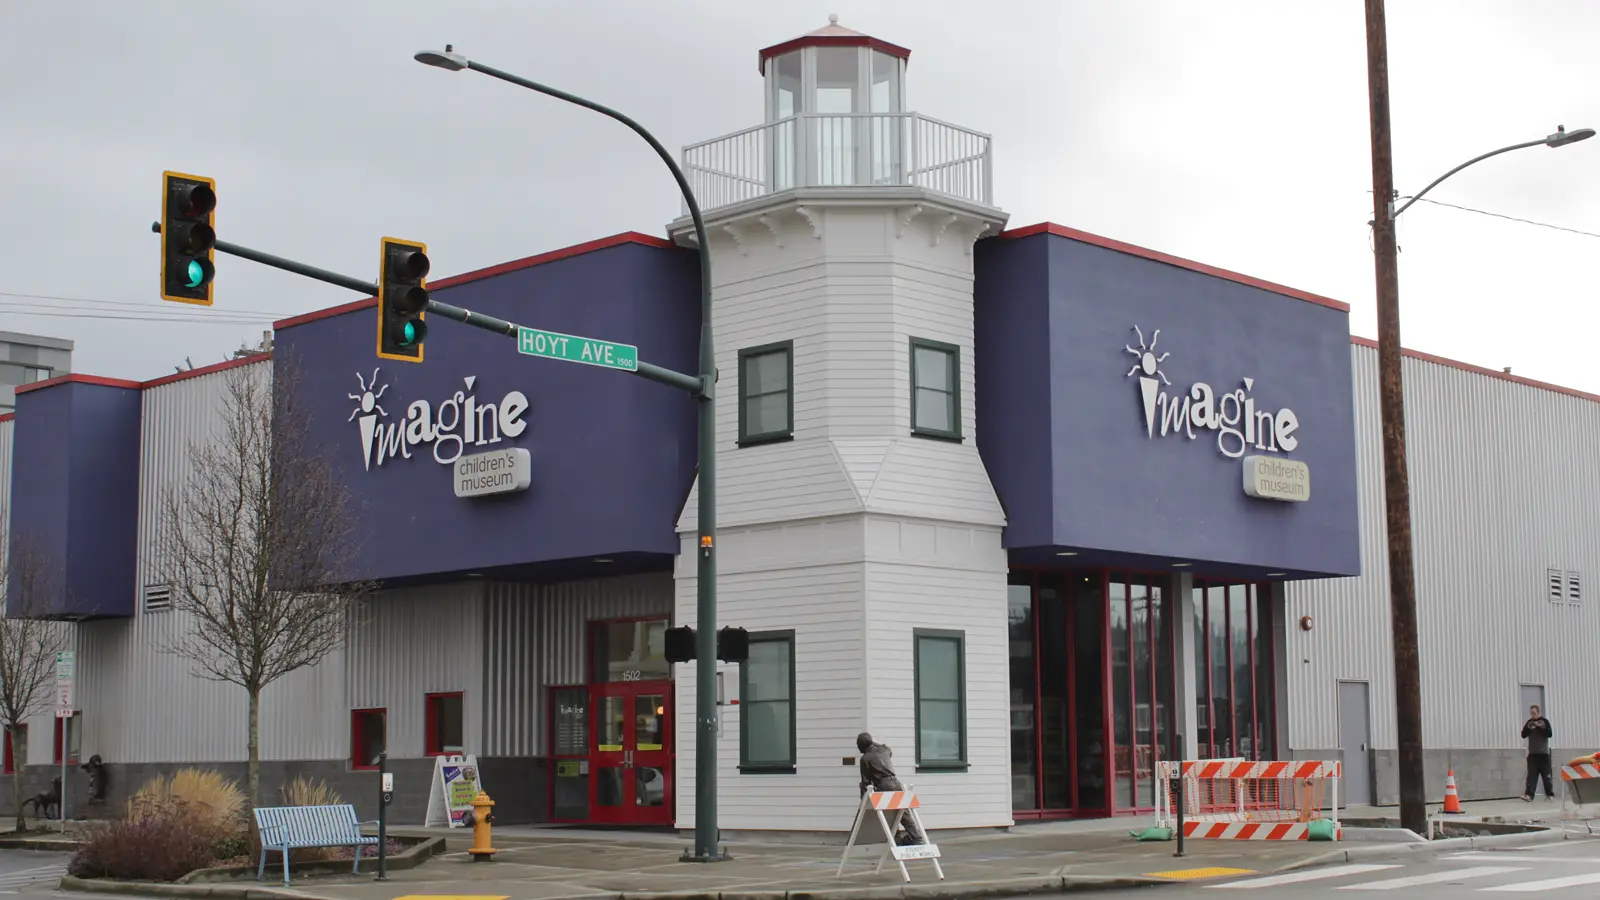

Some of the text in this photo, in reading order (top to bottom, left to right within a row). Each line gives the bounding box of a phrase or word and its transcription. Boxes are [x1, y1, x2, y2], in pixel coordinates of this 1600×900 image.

[522, 331, 633, 367] HOYT AVE 1500
[1126, 324, 1299, 458] imagine
[348, 367, 529, 472] imagine
[459, 452, 515, 476] children's
[1258, 459, 1305, 480] children's
[461, 472, 513, 491] museum
[1260, 477, 1304, 496] museum
[622, 670, 640, 682] 1502
